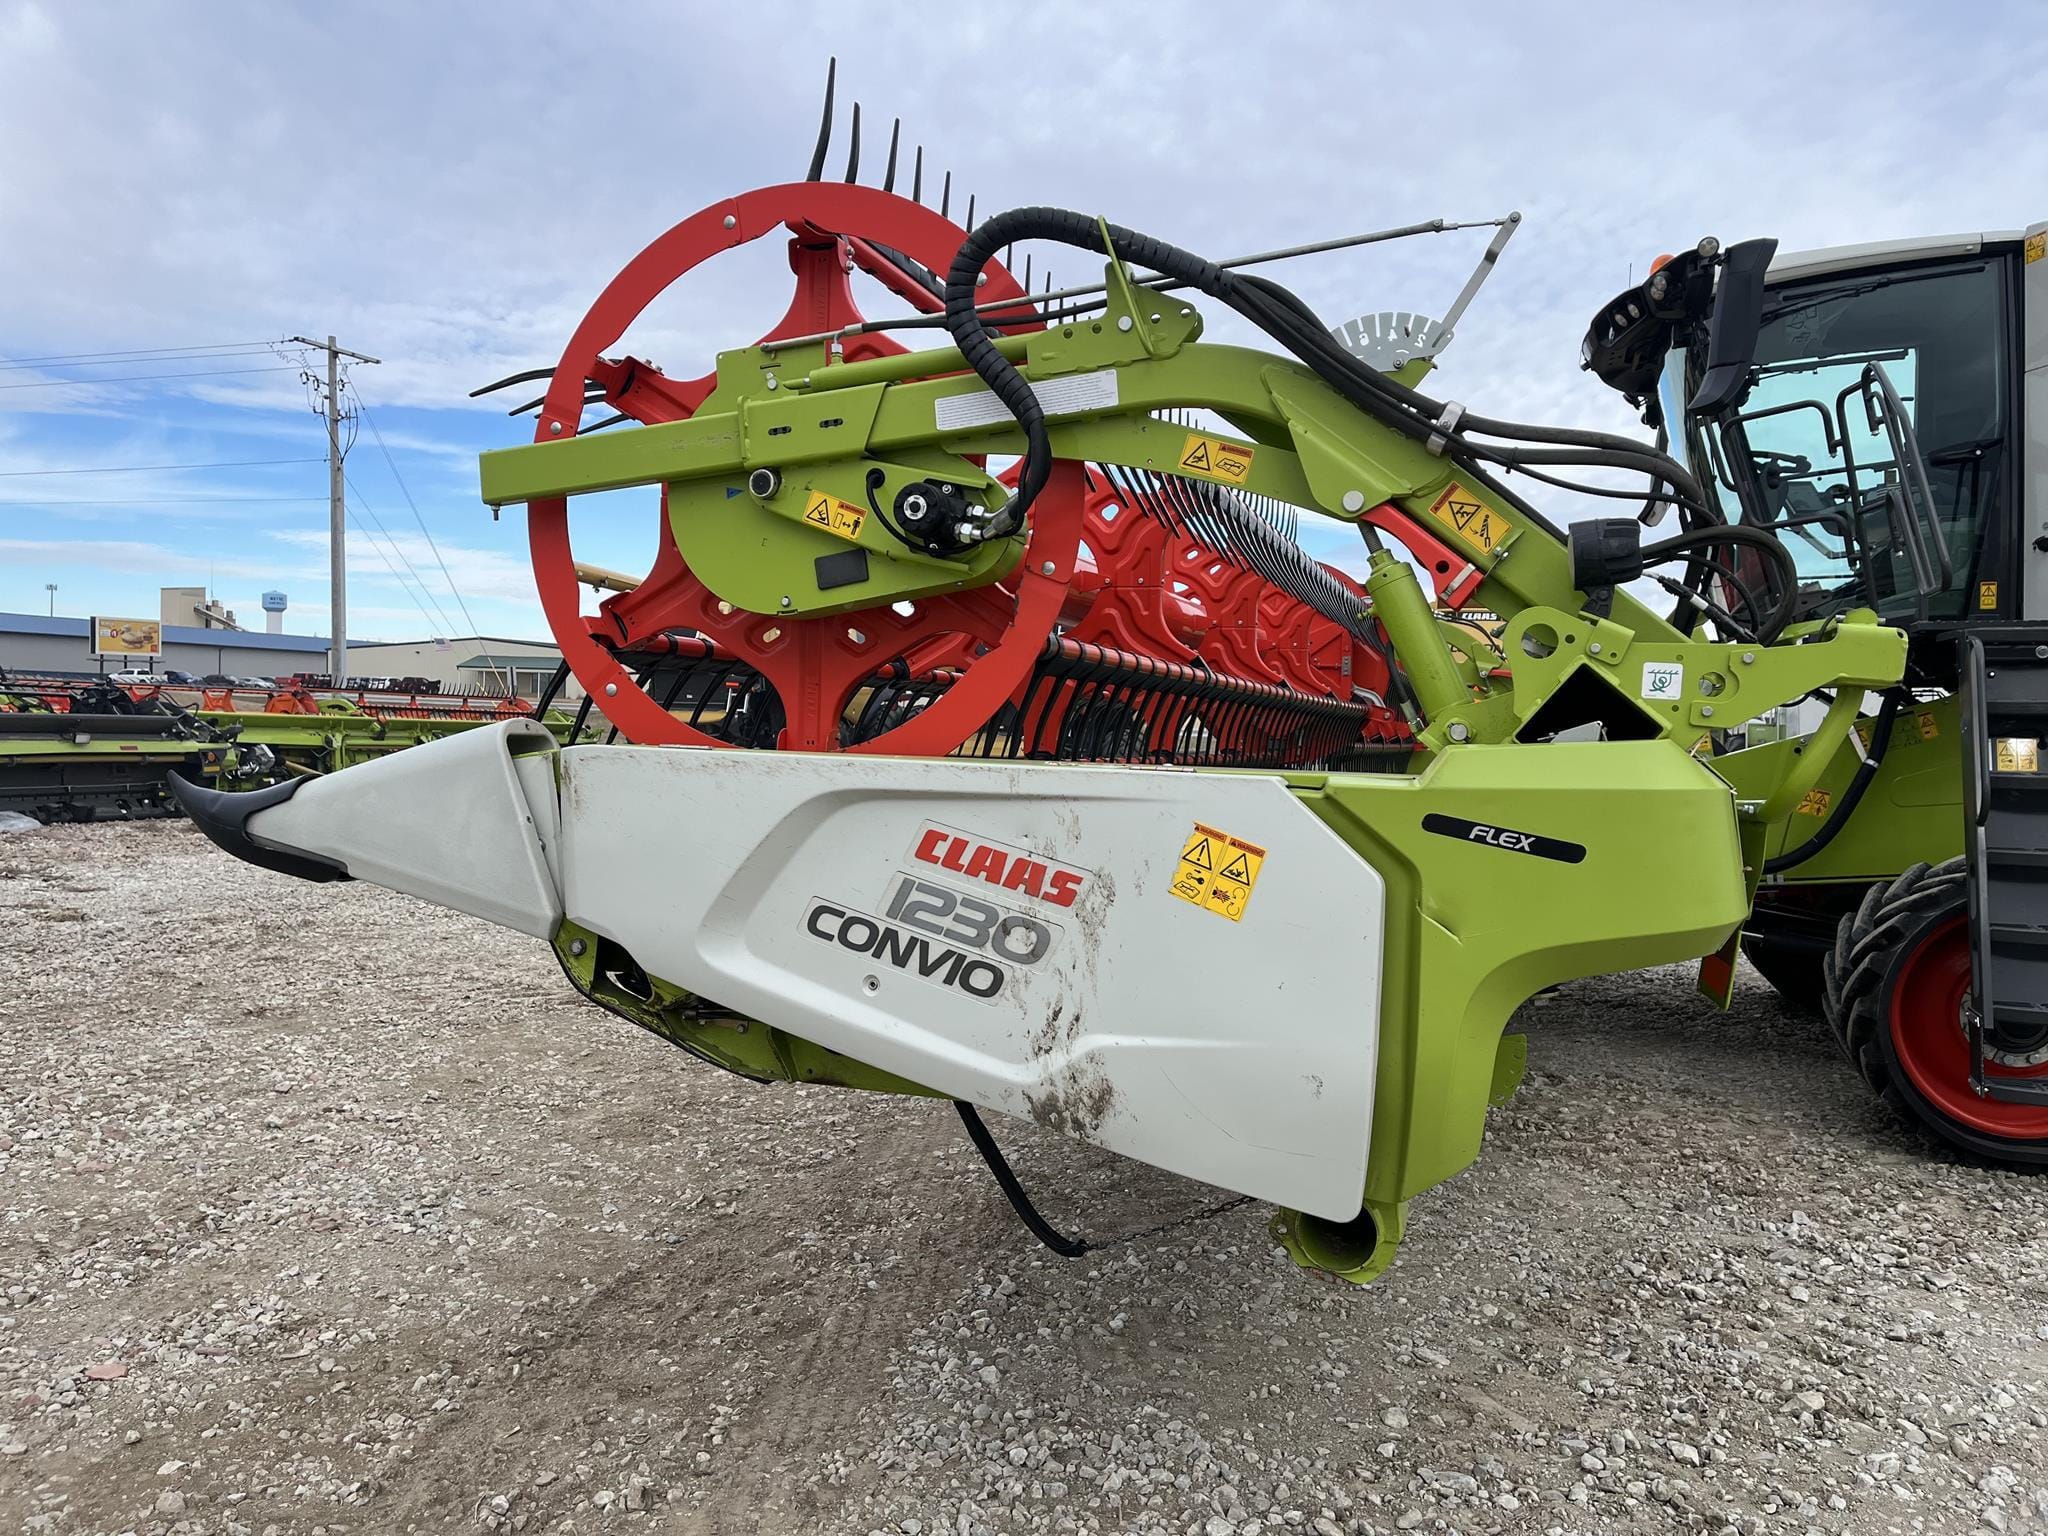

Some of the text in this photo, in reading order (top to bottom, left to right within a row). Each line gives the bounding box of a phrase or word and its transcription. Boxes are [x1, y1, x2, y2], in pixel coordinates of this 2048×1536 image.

[1462, 612, 1498, 620] CLAAS
[914, 828, 1083, 907] CLAAS
[1468, 825, 1536, 851] FLEX
[806, 905, 1004, 999] CONVIO
[885, 878, 1051, 965] 1230
